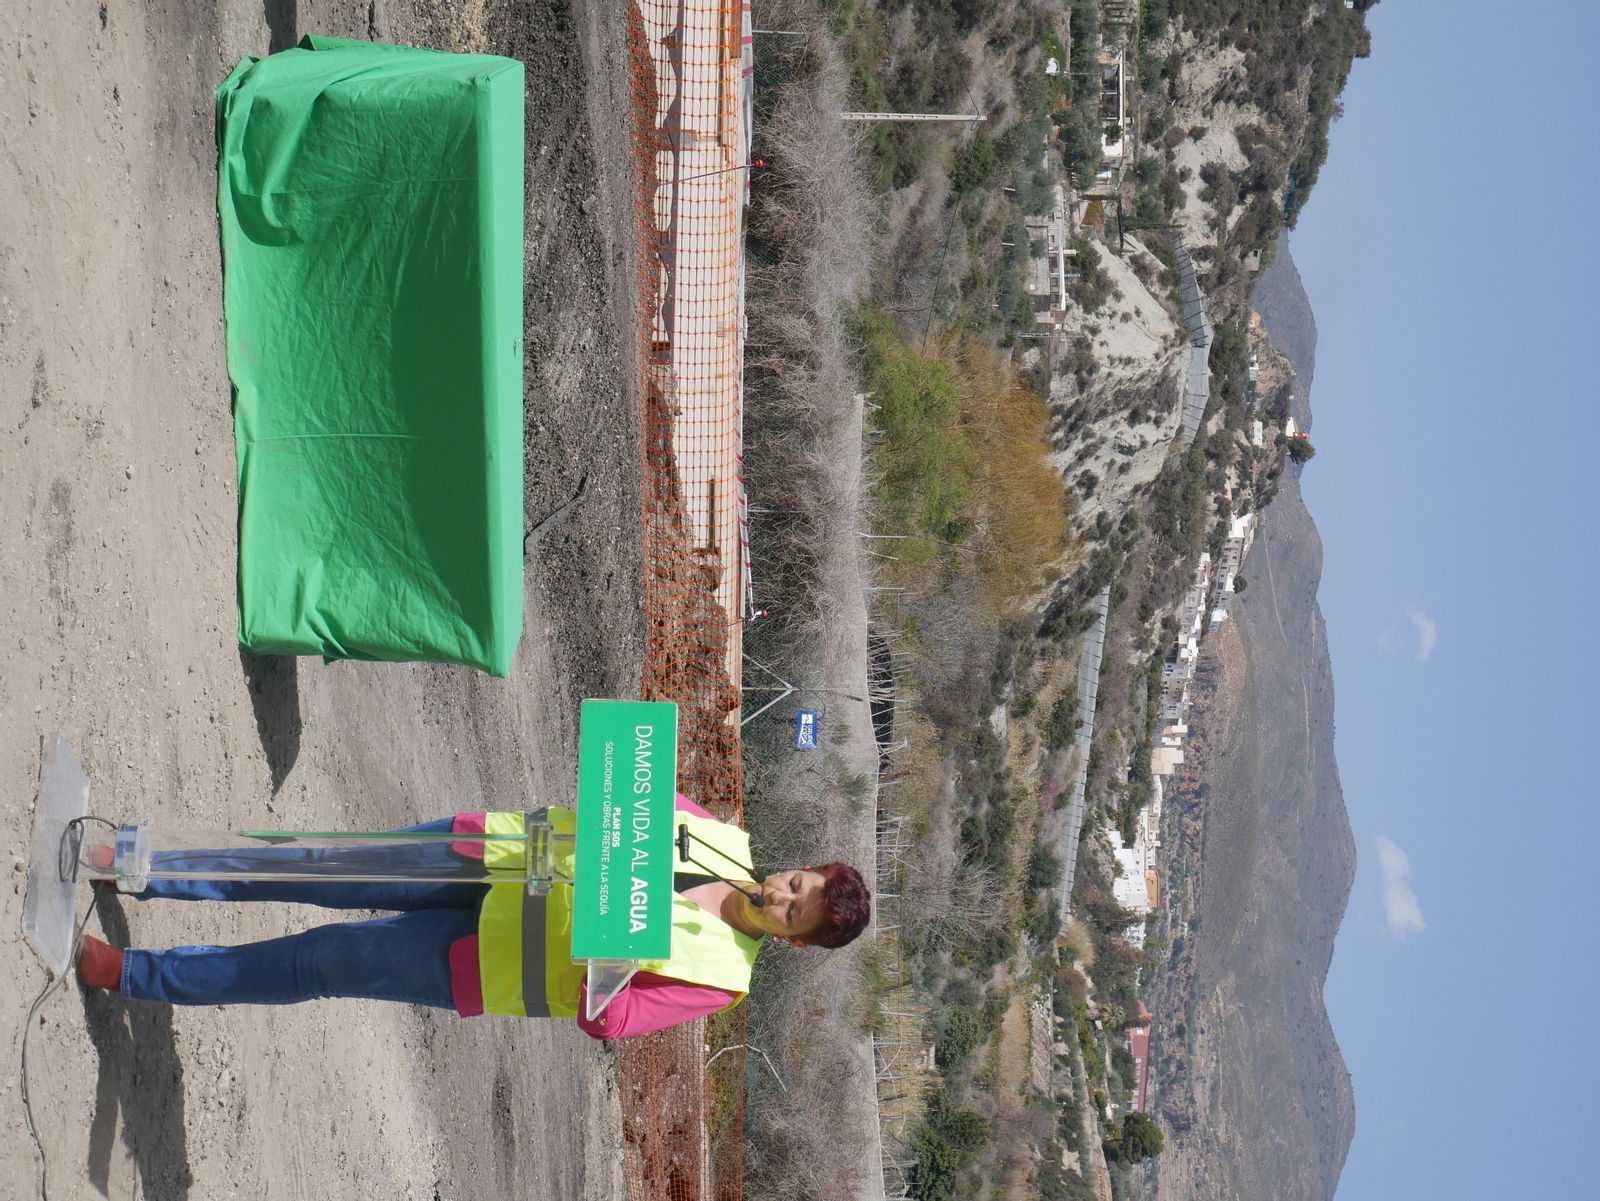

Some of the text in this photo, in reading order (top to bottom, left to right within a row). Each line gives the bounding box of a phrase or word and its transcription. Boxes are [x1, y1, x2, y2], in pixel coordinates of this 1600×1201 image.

[603, 741, 614, 794] SOLUCIONES
[602, 800, 612, 829] OBRAS
[611, 806, 622, 848] PLAN SOS
[629, 725, 653, 934] DAMOS VIDA AL AGUA
[601, 830, 611, 863] FRENTE
[600, 872, 609, 883] LA
[599, 883, 610, 916] SEQUÍA
